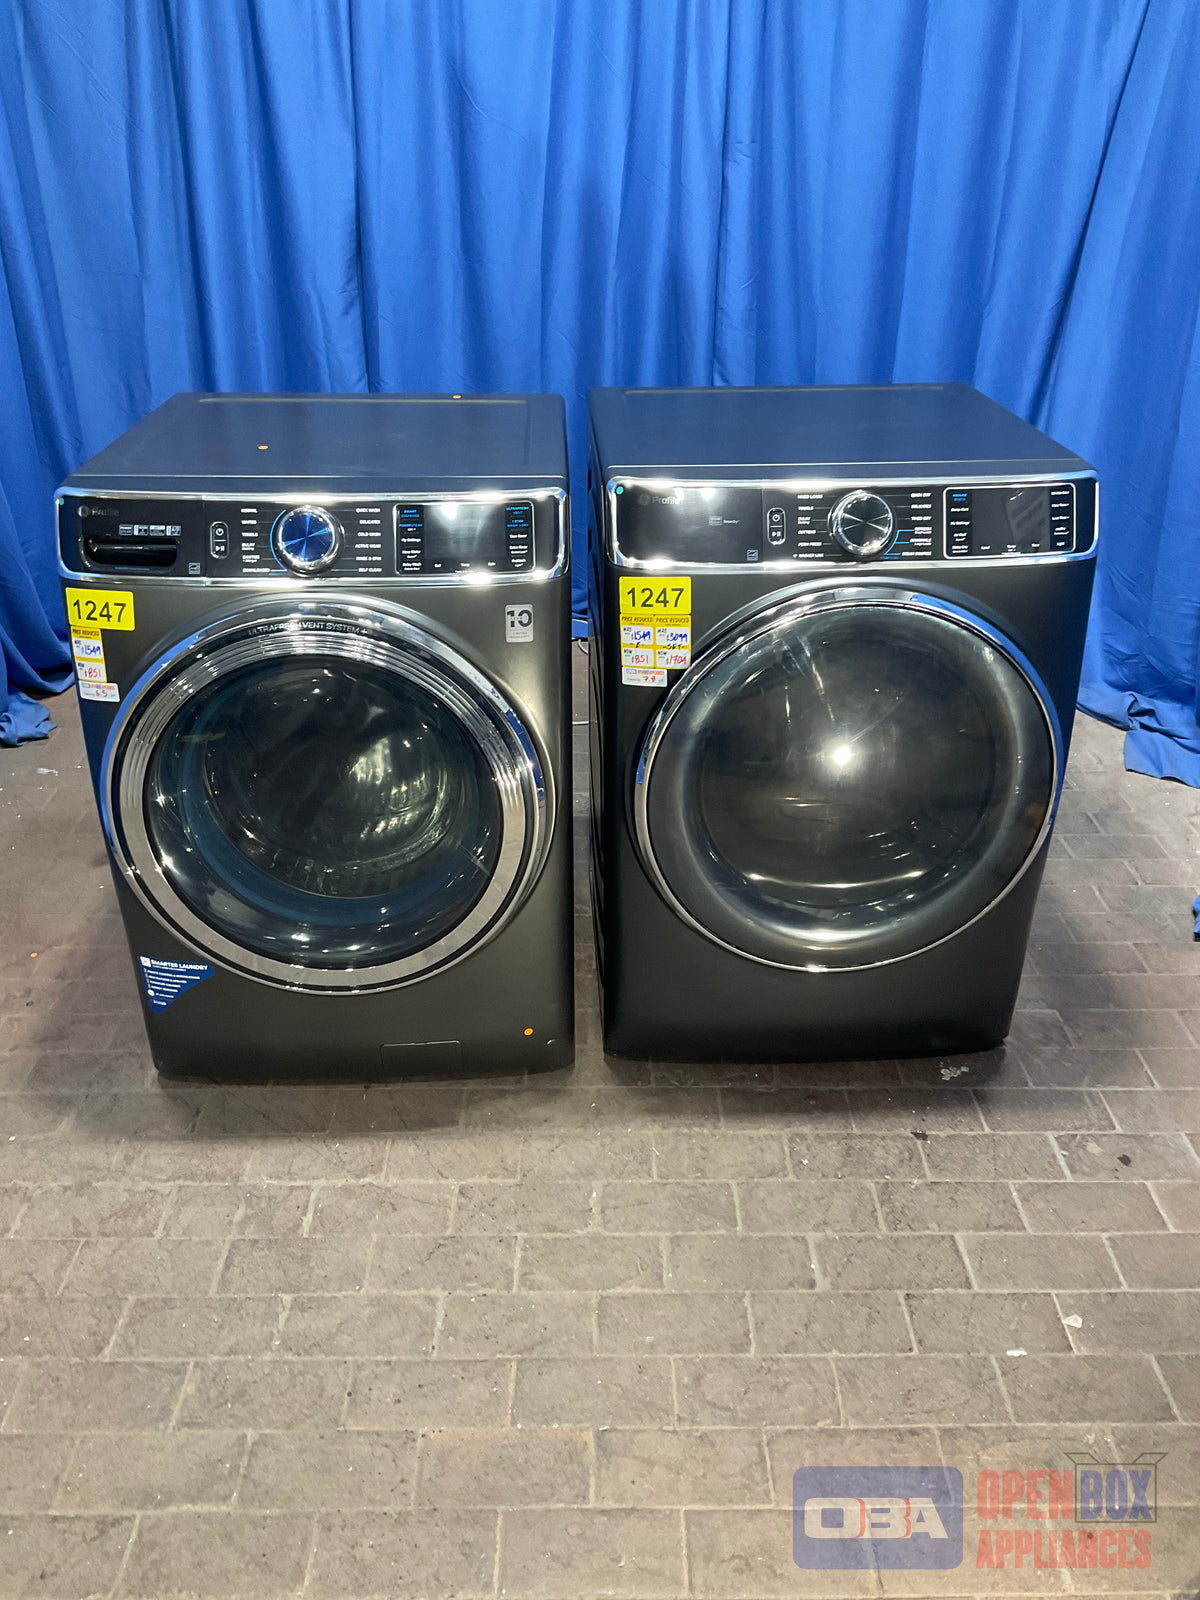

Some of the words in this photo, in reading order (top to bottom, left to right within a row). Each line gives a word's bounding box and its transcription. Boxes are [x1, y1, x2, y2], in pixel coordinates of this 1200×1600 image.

[652, 496, 681, 505] Profile
[627, 587, 684, 607] 1247
[73, 599, 126, 622] 1247
[507, 609, 532, 628] 10
[326, 622, 360, 632] SYSTEM
[151, 959, 178, 968] SMARTER
